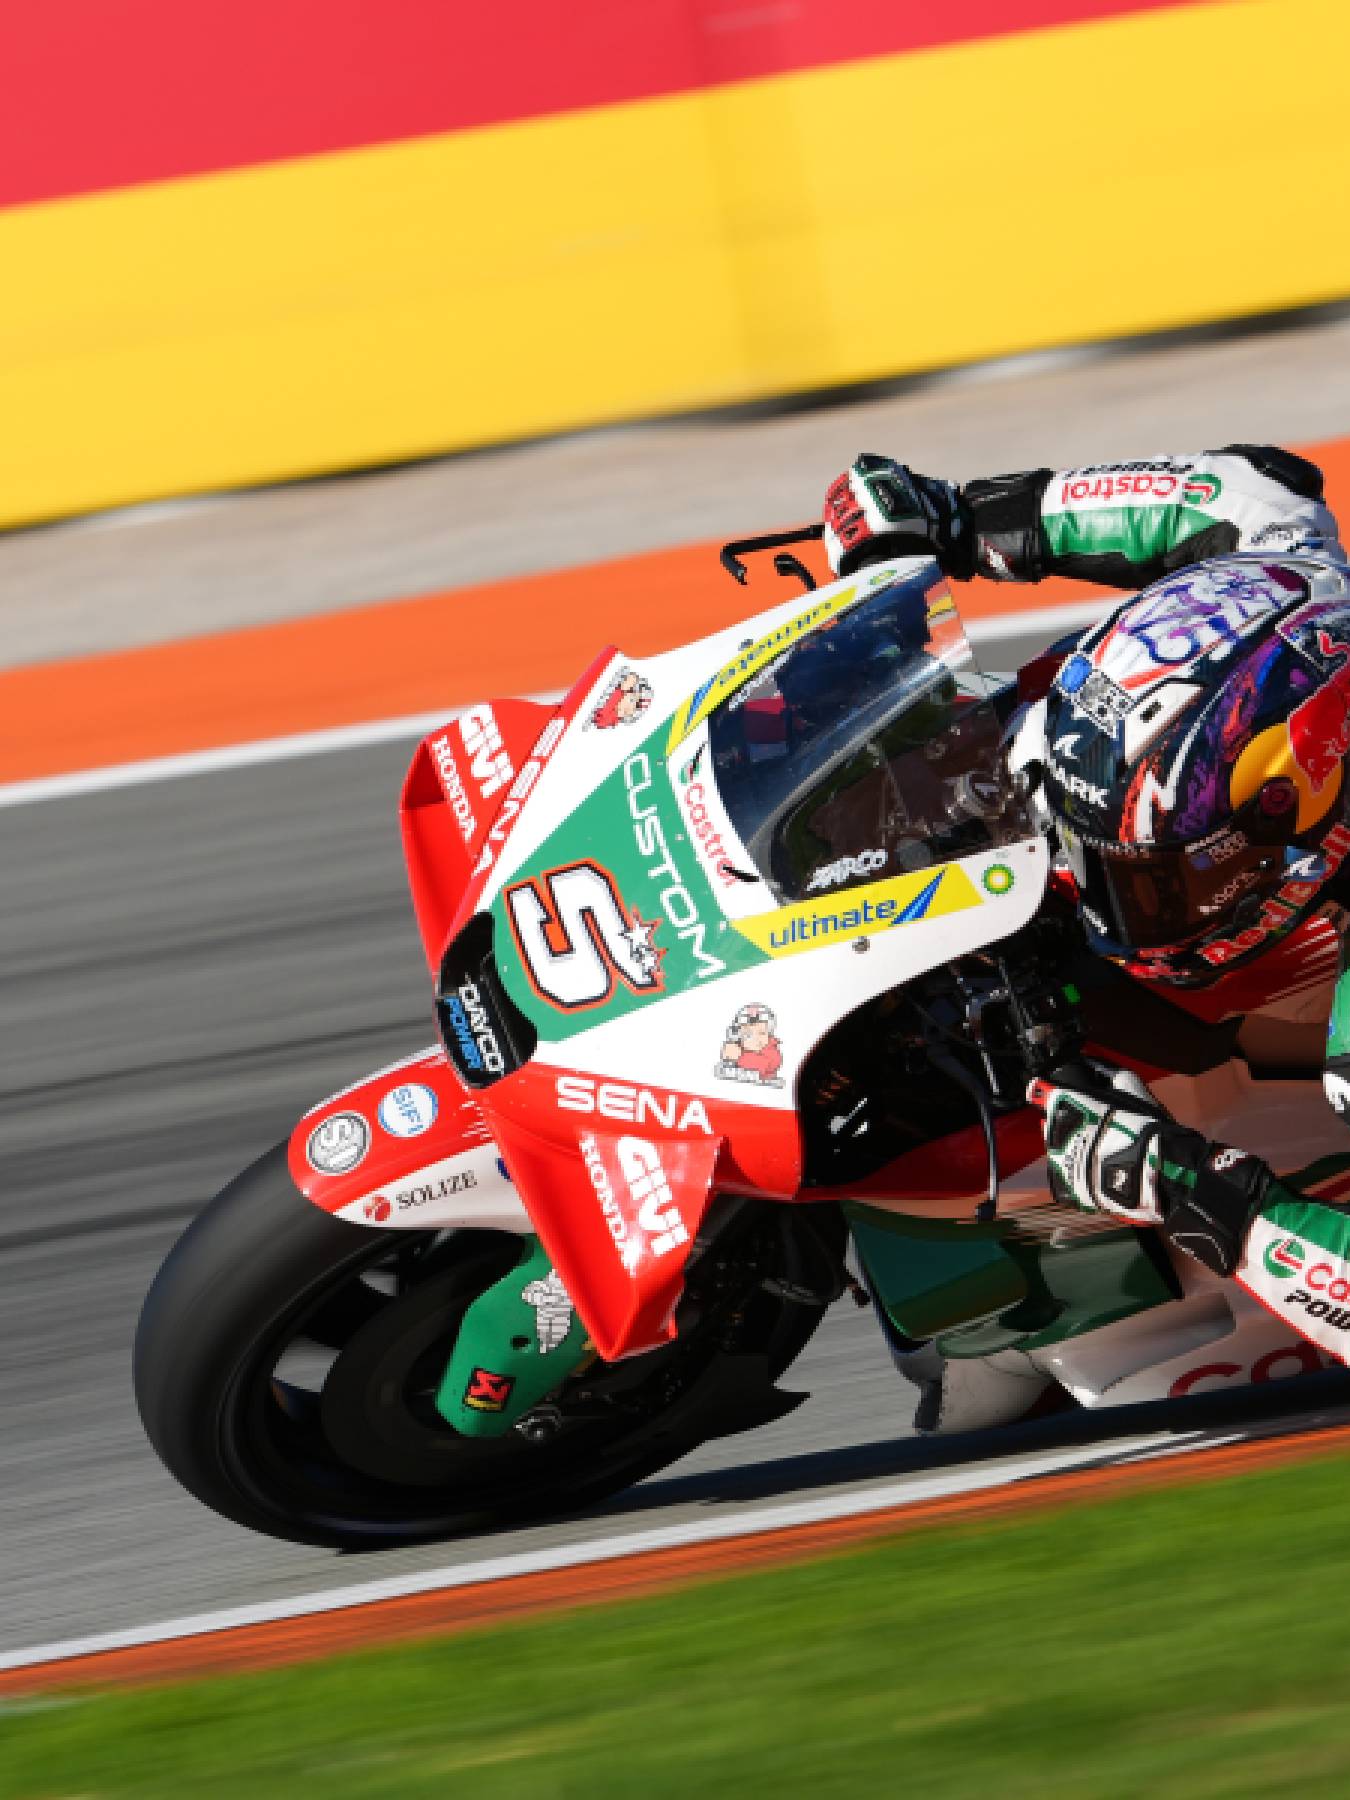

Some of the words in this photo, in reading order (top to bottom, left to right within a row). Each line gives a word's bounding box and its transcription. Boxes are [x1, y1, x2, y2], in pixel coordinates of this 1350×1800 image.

[1062, 472, 1178, 505] Castrol
[432, 735, 476, 842] HONDA
[458, 703, 513, 799] GIVI
[624, 753, 726, 977] CUSTOM
[504, 859, 668, 1013] 5
[770, 900, 897, 948] ultimate
[444, 996, 484, 1070] POWER
[459, 985, 505, 1073] DAYCO
[557, 1076, 712, 1134] SENA
[396, 1169, 479, 1211] SOLIZE
[579, 1131, 642, 1277] HONDA
[617, 1137, 690, 1256] GIVI
